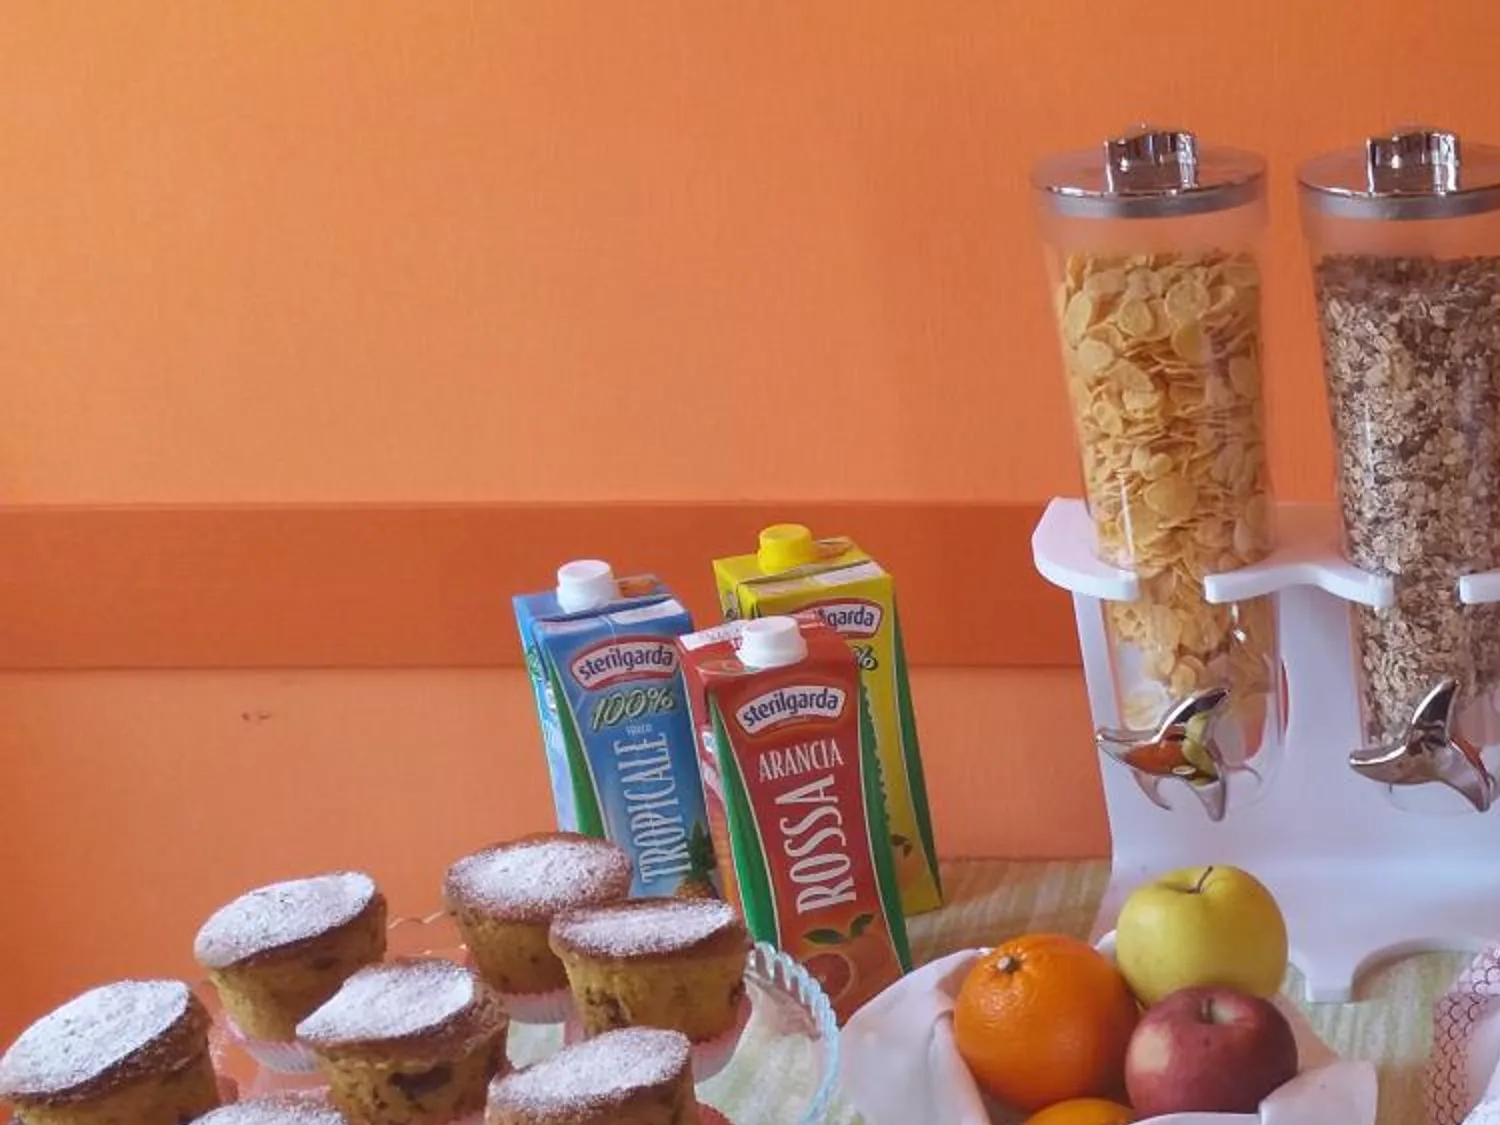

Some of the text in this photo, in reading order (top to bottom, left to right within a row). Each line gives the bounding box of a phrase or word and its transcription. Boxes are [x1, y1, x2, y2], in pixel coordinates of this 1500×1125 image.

[578, 645, 674, 680] sterilgarda
[592, 686, 676, 732] 100%
[743, 688, 840, 727] sterilgarda
[758, 738, 844, 783] ARANCIA
[613, 732, 693, 884] TROPICALE
[775, 774, 857, 914] ROSSA
